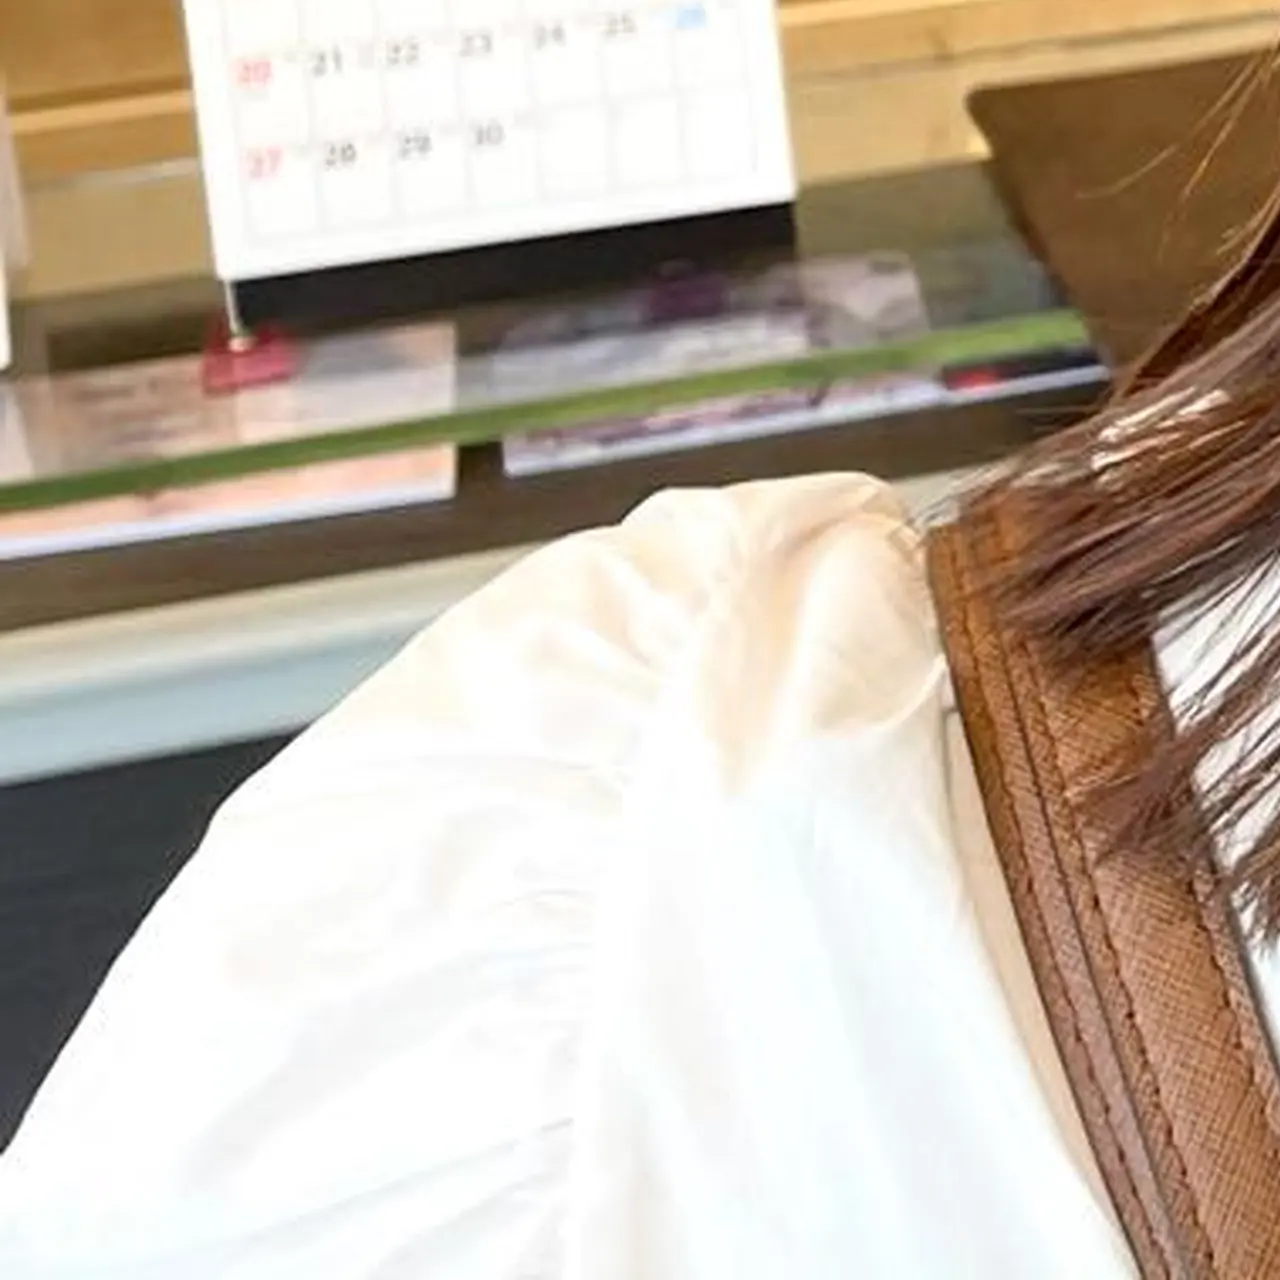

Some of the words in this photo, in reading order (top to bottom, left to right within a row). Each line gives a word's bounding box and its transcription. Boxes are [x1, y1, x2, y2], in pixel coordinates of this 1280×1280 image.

[311, 45, 343, 78] 21
[384, 36, 421, 68] 22
[459, 29, 494, 58] 23
[533, 22, 567, 51] 24
[602, 11, 639, 39] 25
[323, 141, 358, 172] 28
[397, 130, 433, 161] 29
[473, 119, 507, 148] 30
